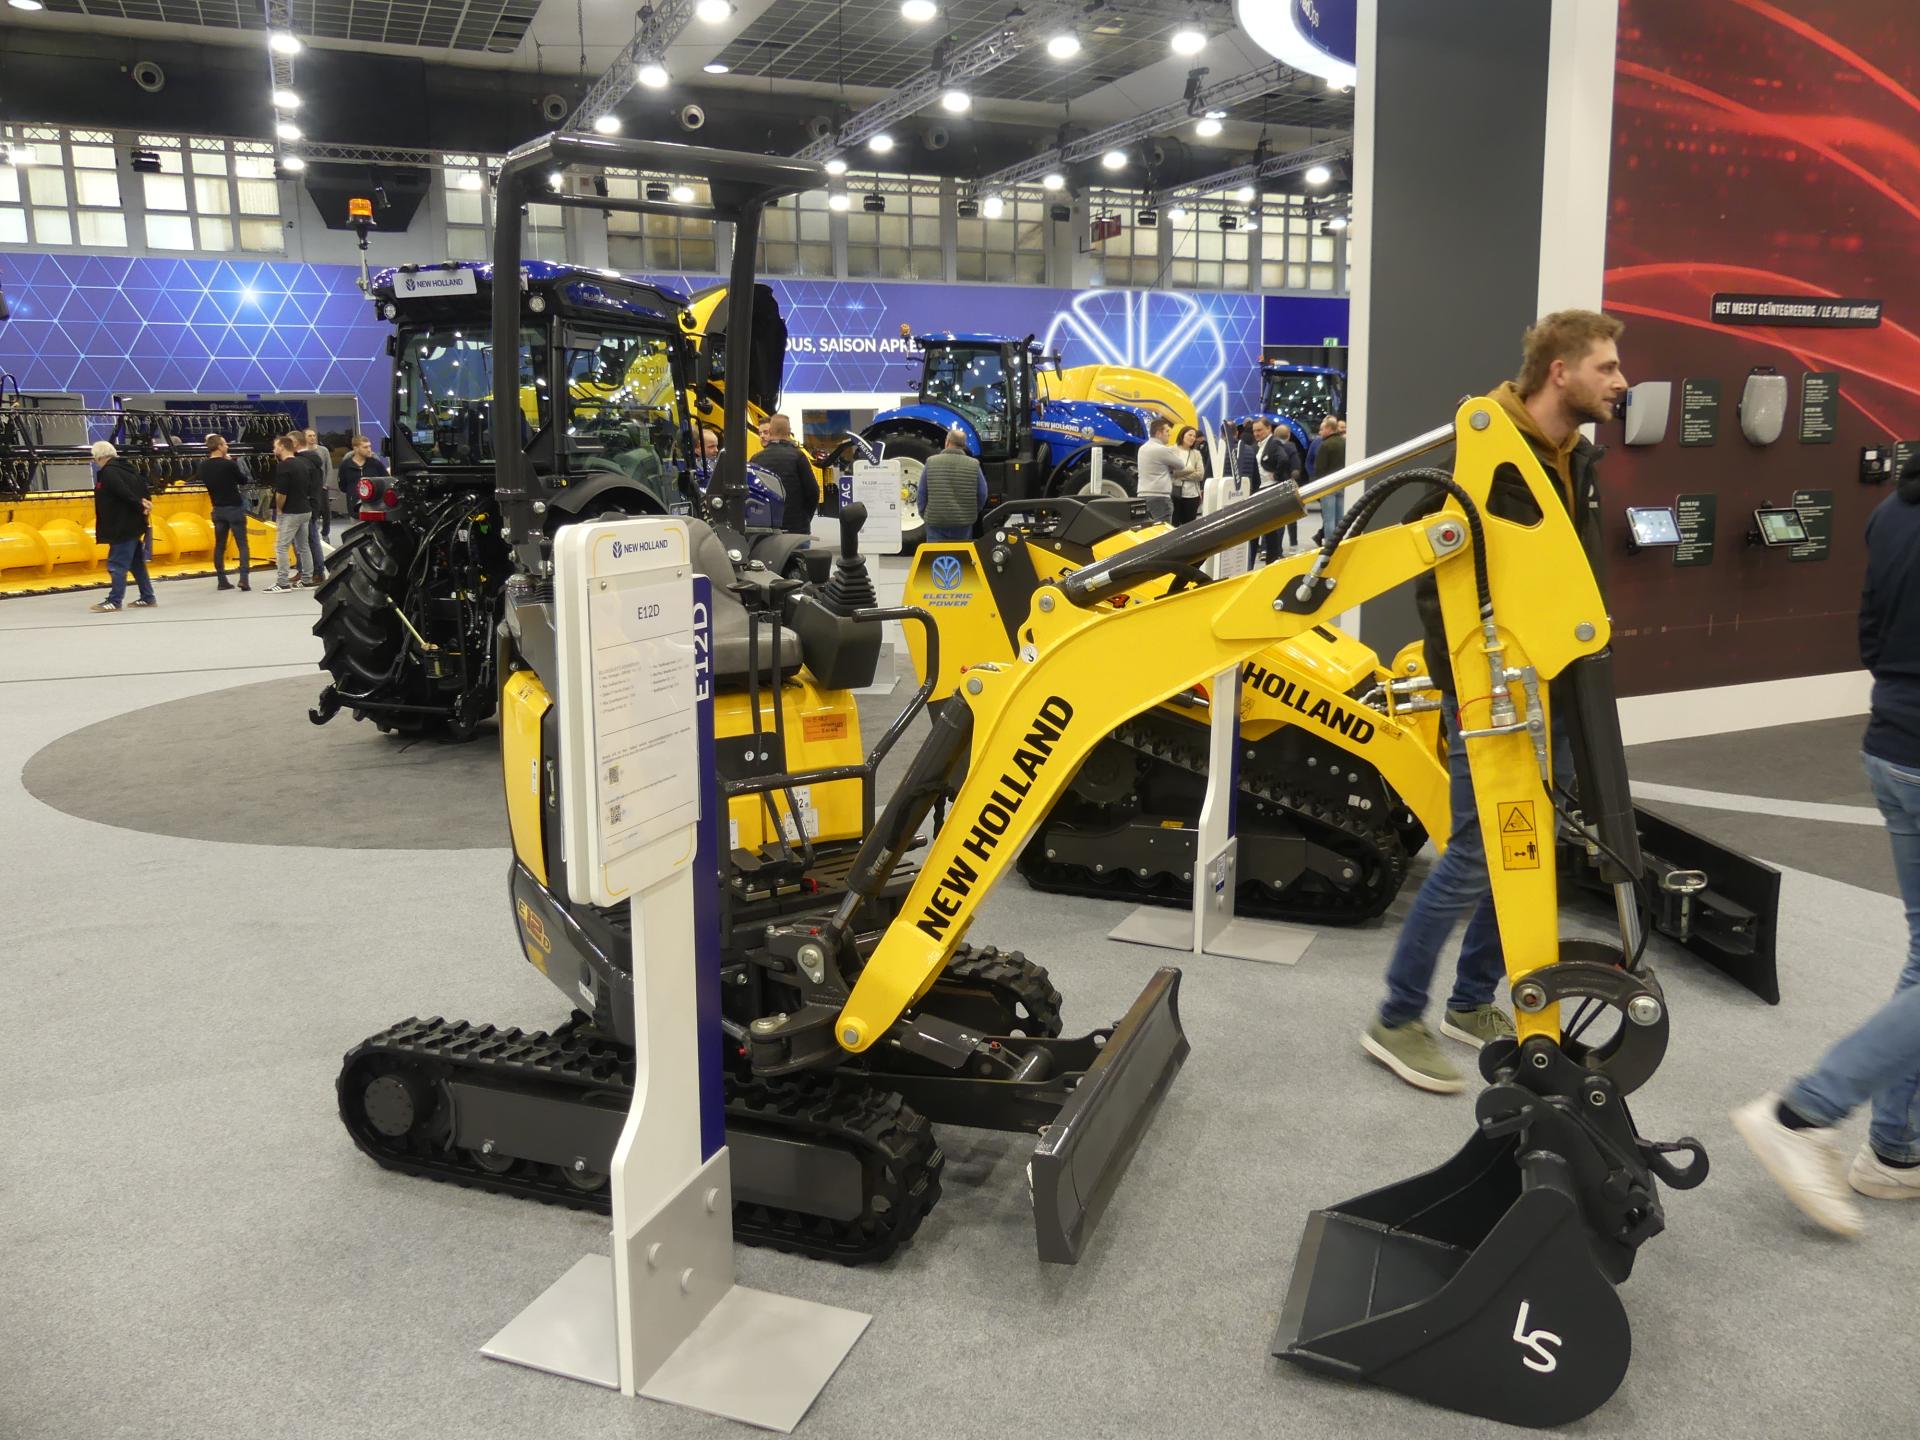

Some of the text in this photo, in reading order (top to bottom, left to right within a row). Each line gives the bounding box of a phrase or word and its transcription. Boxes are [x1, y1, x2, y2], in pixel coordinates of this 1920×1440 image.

[416, 278, 463, 289] NEW HOLLAND
[1715, 302, 1730, 314] HET
[1732, 302, 1757, 315] MEEST
[1758, 302, 1816, 317] GEÏNTEGREERDE
[1821, 305, 1831, 318] LE
[1831, 306, 1849, 318] PLUS
[819, 338, 877, 352] SAISON
[1036, 420, 1080, 433] NEW HOLLAND
[857, 440, 879, 465] PREVIEW
[841, 483, 851, 499] AC
[624, 539, 668, 553] NEW HOLLAND
[637, 604, 660, 620] E12D
[693, 602, 709, 702] E12D
[1242, 661, 1375, 745] HOLLAND
[916, 695, 1074, 943] NEW HOLLAND
